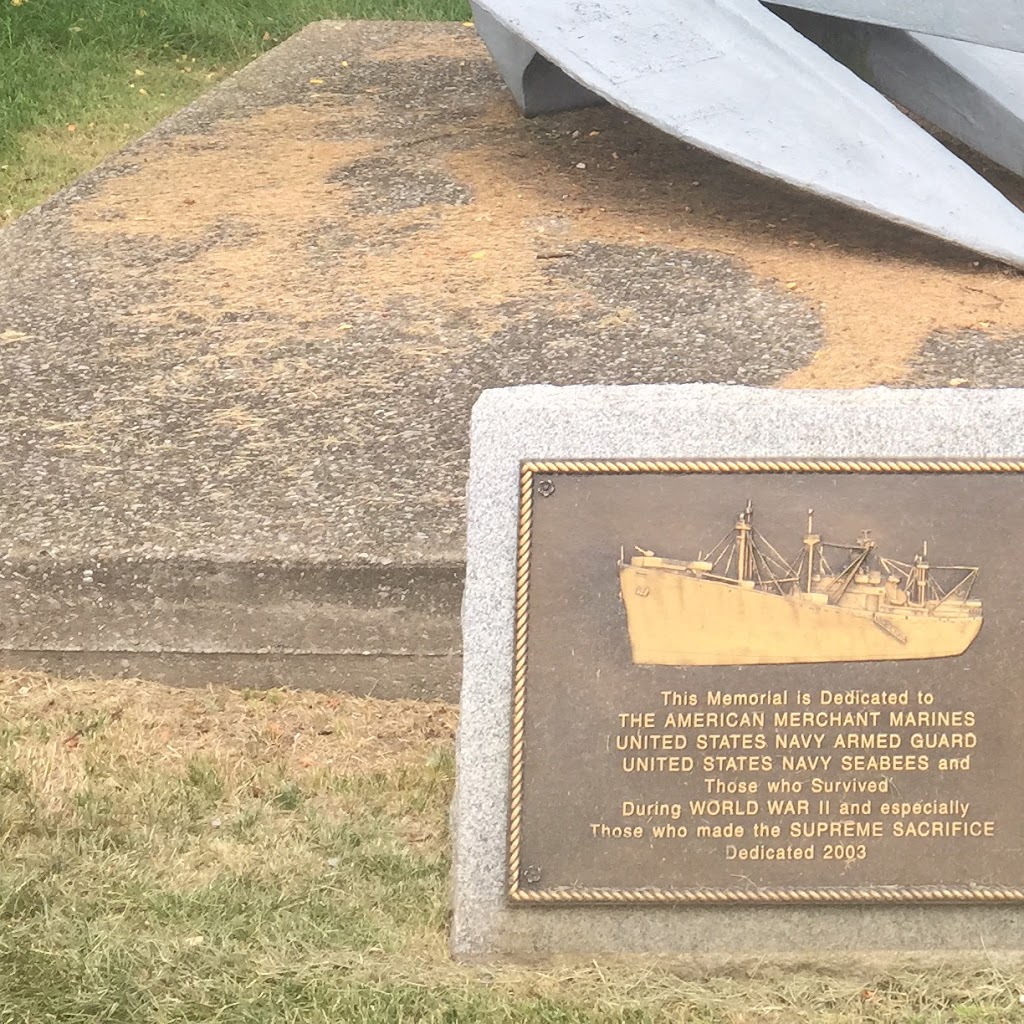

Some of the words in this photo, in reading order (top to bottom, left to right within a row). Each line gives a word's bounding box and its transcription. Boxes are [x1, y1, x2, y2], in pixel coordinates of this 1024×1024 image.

[661, 691, 698, 706] This
[707, 690, 787, 706] Memorial
[797, 690, 811, 705] is
[820, 690, 908, 705] Dedicated
[917, 690, 934, 705] to
[618, 713, 656, 728] THE
[664, 712, 765, 728] AMERICAN
[774, 712, 881, 727] MERCHANT
[889, 711, 976, 727] MARINES
[616, 734, 687, 750] UNITED
[696, 734, 766, 750] STATES
[775, 734, 825, 749] NAVY
[833, 733, 901, 749] ARMED
[910, 733, 977, 749] GUARD
[622, 756, 694, 772] UNITED
[703, 756, 772, 771] STATES
[782, 756, 832, 771] NAVY
[841, 755, 929, 771] SEABEES
[938, 755, 970, 771] and
[704, 779, 758, 794] Those
[767, 779, 802, 793] who
[811, 777, 888, 793] Survived
[622, 801, 681, 819] During
[689, 800, 759, 816] WORLD
[767, 800, 809, 815] WAR
[819, 800, 830, 815] II
[839, 800, 872, 815] and
[880, 800, 970, 818] especially
[590, 823, 643, 839] Those
[652, 824, 688, 838] who
[697, 823, 744, 838] made
[753, 823, 781, 838] the
[790, 822, 883, 837] SUPREME
[892, 821, 995, 837] SACRIFICE
[725, 844, 814, 860] Dedicated
[823, 844, 867, 860] 2003
